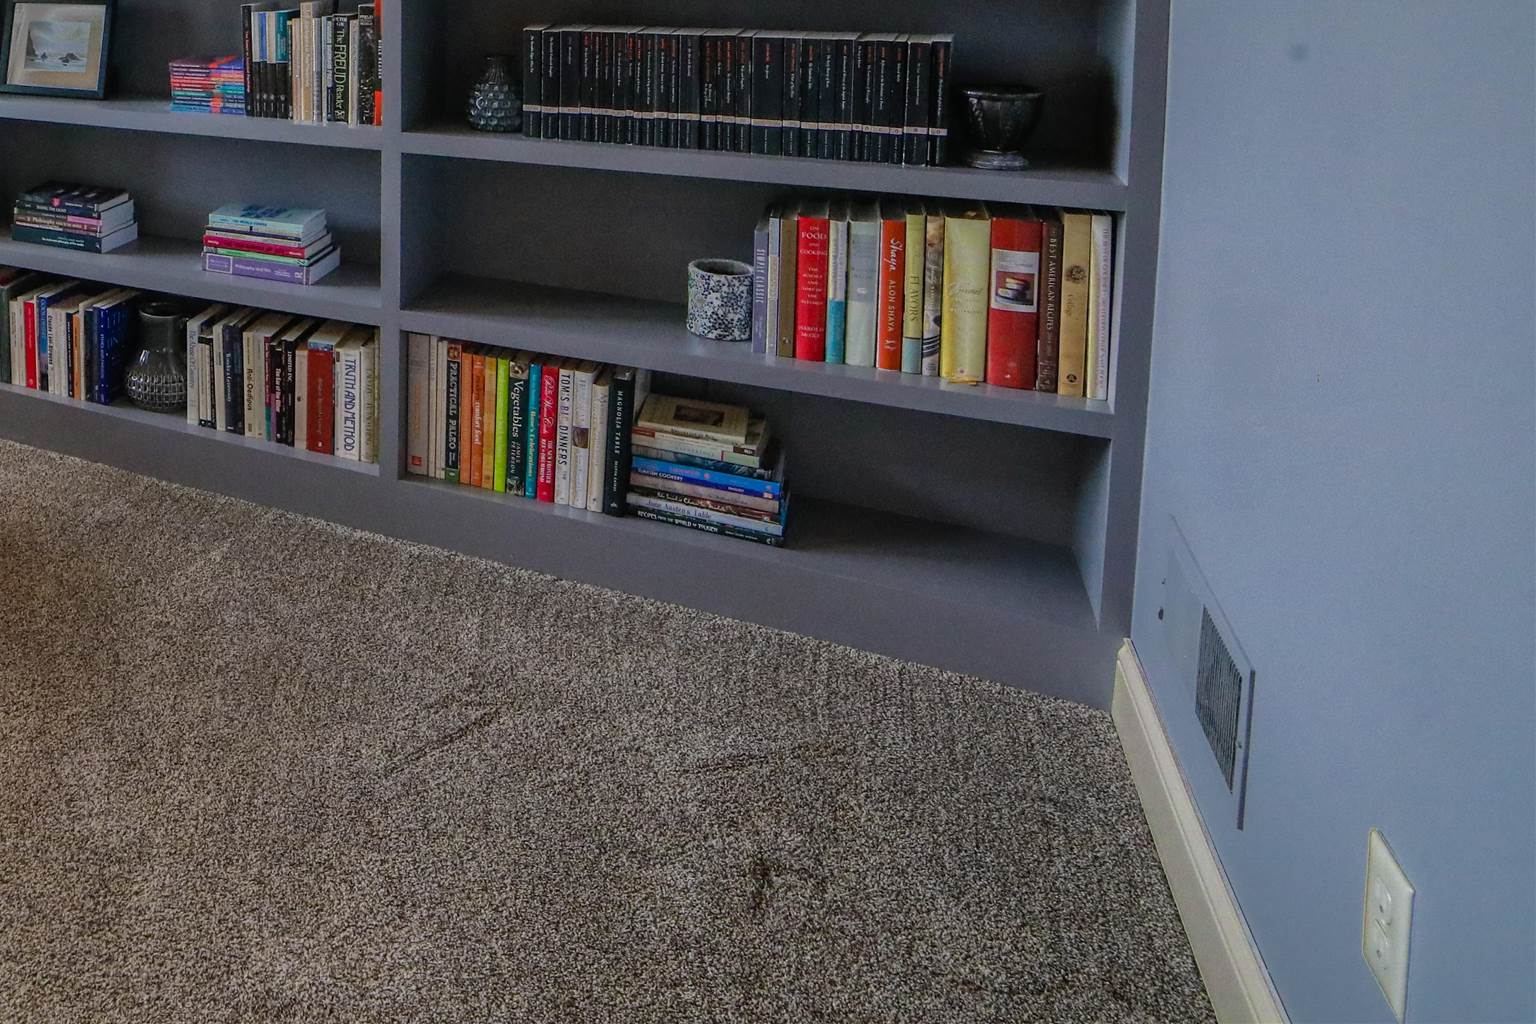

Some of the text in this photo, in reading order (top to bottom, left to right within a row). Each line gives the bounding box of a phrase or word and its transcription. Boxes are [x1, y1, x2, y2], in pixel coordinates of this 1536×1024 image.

[334, 30, 347, 109] The FREUD Reader
[799, 249, 828, 257] COOKING
[800, 231, 828, 240] FOOD
[754, 248, 767, 304] SIMPLY CLASSIC
[881, 237, 904, 332] Shaya ALON SHAYA
[909, 275, 921, 322] FLAVORS
[1046, 238, 1057, 331] BEST AMERICAN RECIPES
[246, 368, 254, 411] Anti-Oedipus
[343, 359, 357, 452] TRUTH AND METHOD
[448, 362, 458, 450] PRACTICAL PALEO
[510, 380, 525, 438] Vegetables
[557, 374, 571, 466] TOM'S DINNERS
[613, 390, 624, 455] MAGNOLIA TABLE
[510, 441, 518, 474] PETERSON
[527, 434, 536, 477] Celebrations
